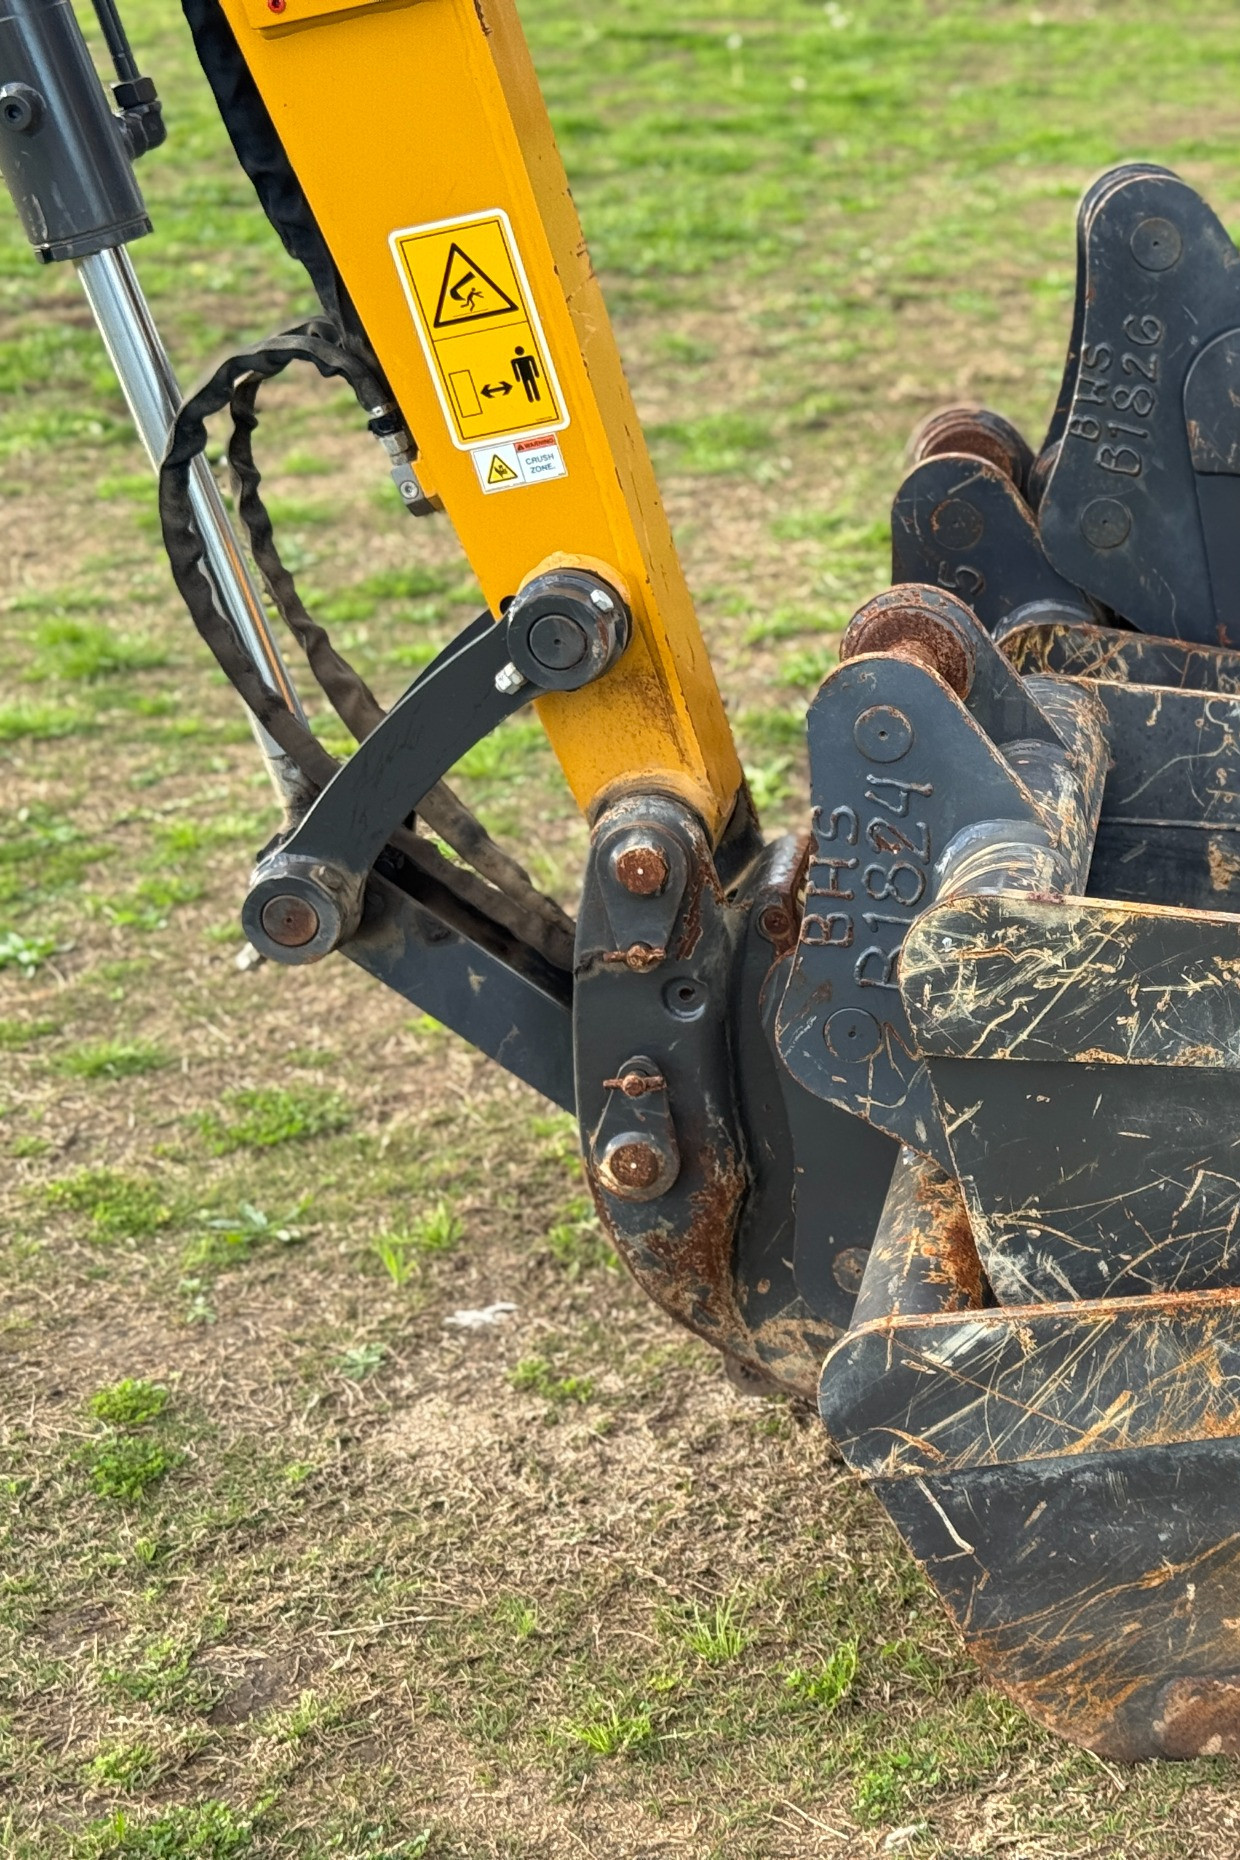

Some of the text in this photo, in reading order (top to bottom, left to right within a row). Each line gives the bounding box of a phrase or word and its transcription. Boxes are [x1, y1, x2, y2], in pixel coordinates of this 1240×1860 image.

[1069, 342, 1113, 442] BHS
[1095, 313, 1163, 478] B1826
[524, 437, 554, 448] WARNING
[525, 453, 555, 465] CRUSH
[799, 804, 861, 949] BHS
